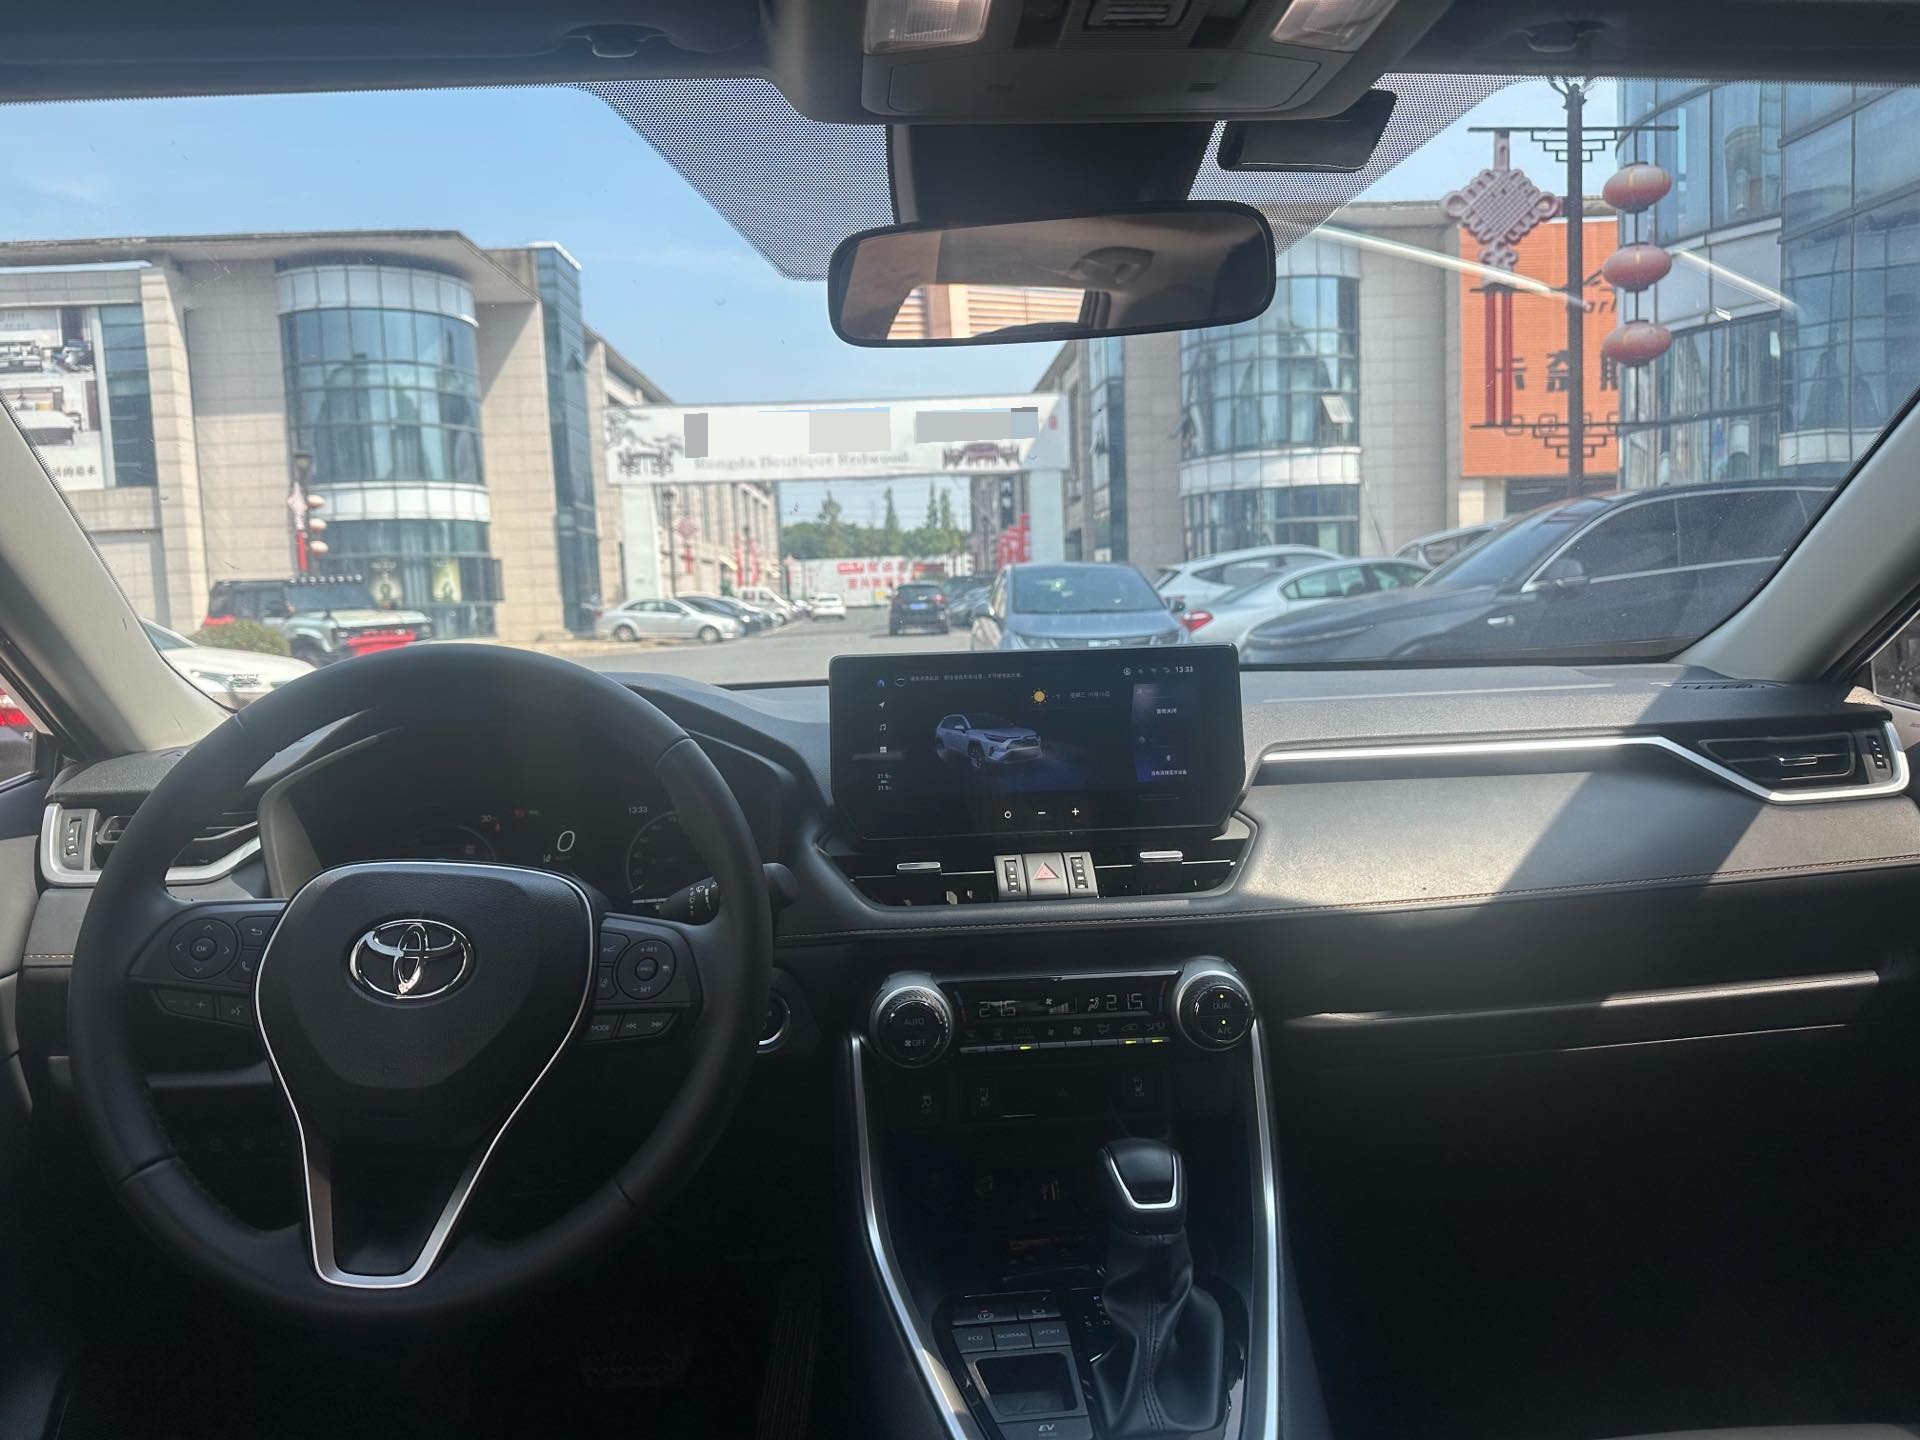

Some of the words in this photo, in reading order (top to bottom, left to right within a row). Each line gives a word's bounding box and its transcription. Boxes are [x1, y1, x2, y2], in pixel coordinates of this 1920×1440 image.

[760, 453, 834, 470] Boutique
[557, 830, 575, 852] 0
[904, 1017, 925, 1025] AUTO
[1216, 1026, 1232, 1035] A/C
[912, 1039, 926, 1047] OFF
[997, 1332, 1027, 1340] NORMAL
[1038, 1424, 1055, 1432] EV
